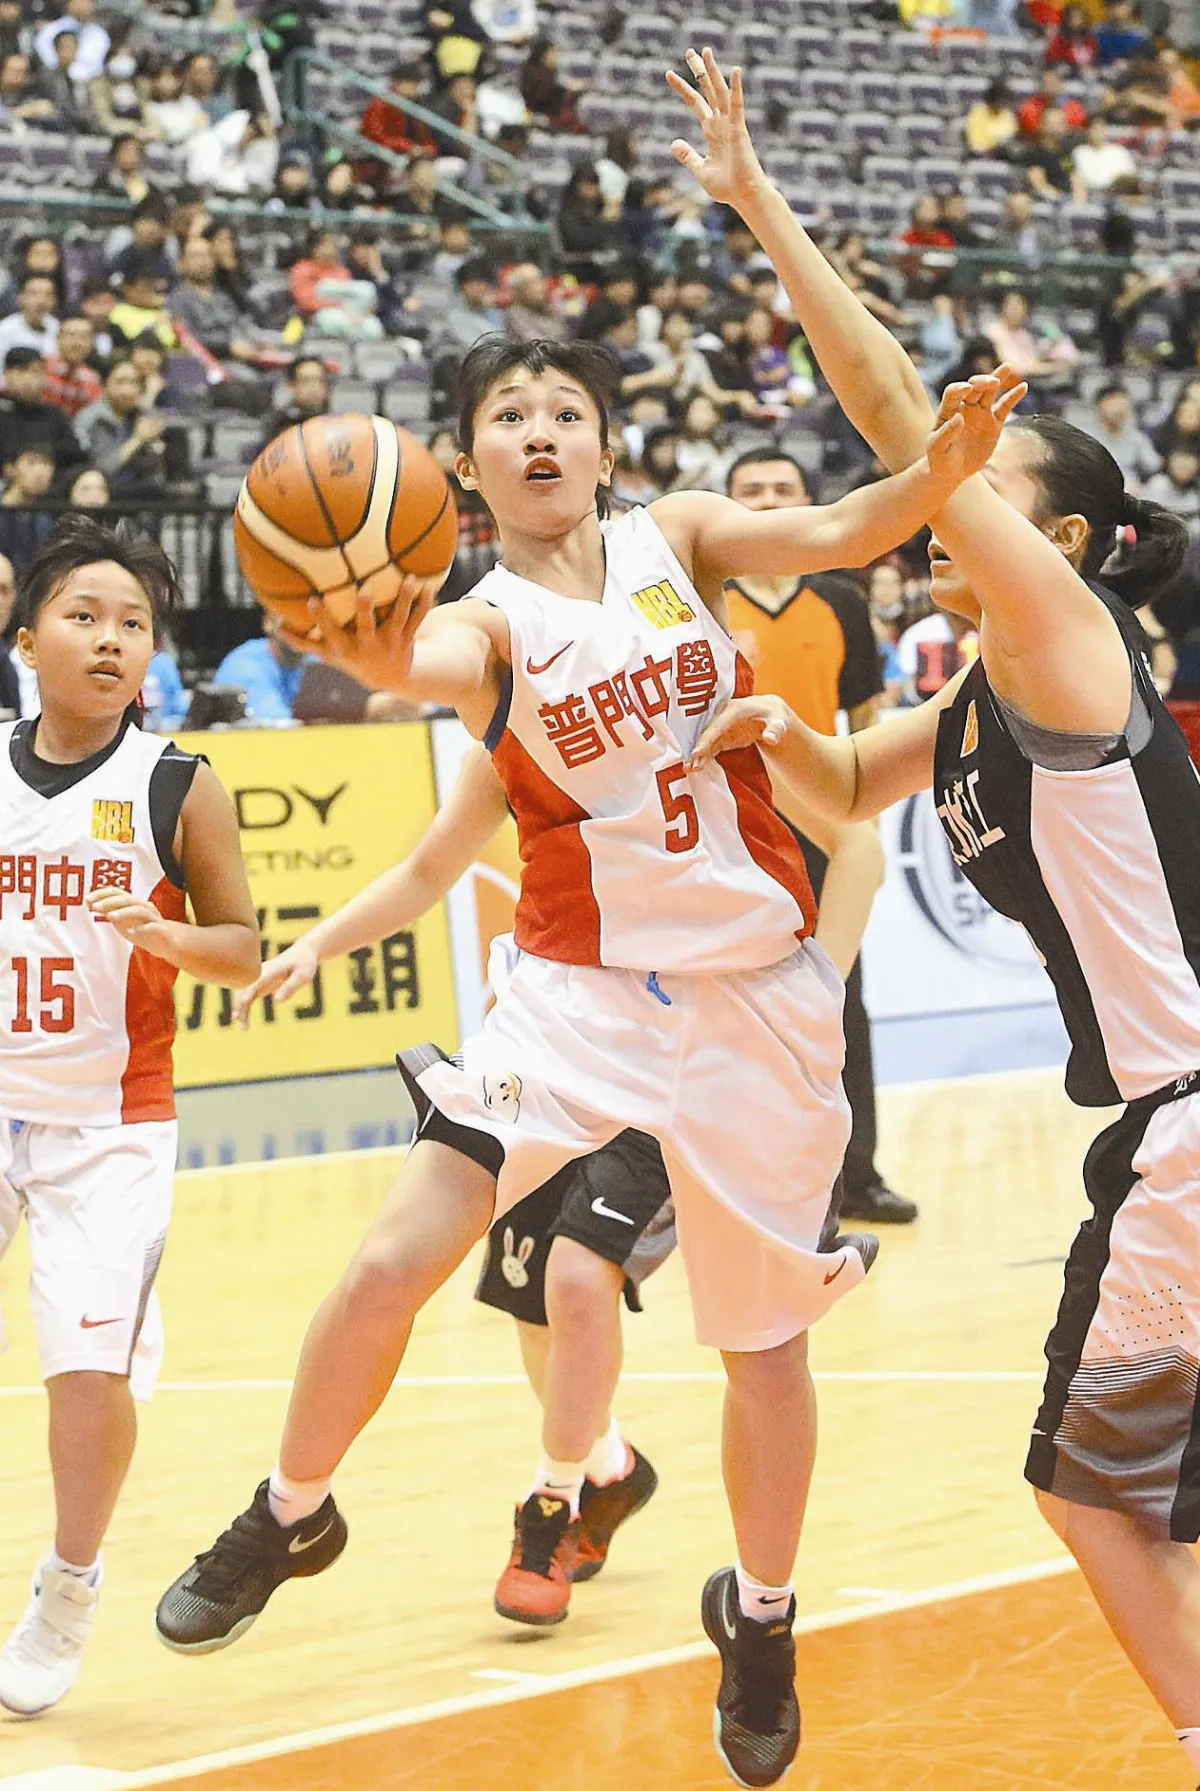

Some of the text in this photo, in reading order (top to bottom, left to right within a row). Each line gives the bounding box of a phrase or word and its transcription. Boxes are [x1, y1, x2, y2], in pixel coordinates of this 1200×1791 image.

[630, 579, 697, 630] HBL
[537, 639, 718, 770] 普門中學
[91, 799, 135, 844] HBL
[655, 761, 700, 854] 5
[11, 956, 75, 1033] 15
